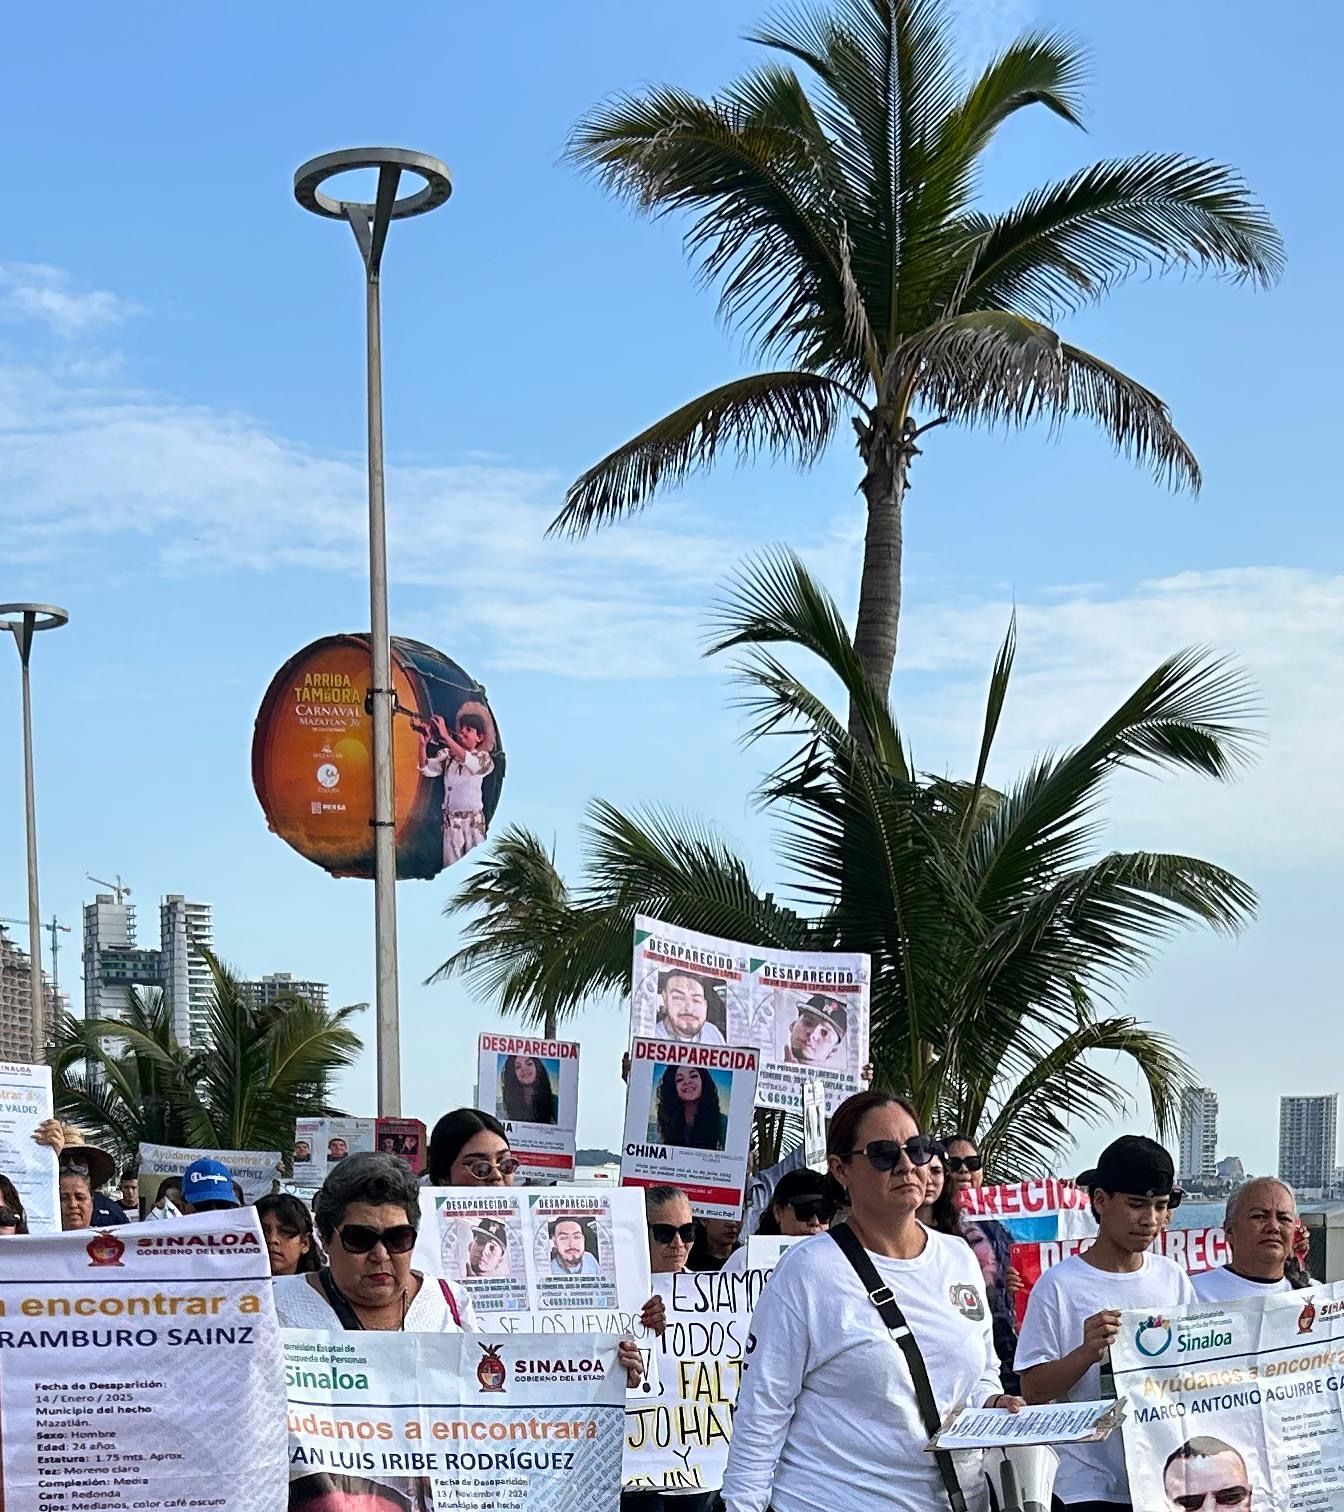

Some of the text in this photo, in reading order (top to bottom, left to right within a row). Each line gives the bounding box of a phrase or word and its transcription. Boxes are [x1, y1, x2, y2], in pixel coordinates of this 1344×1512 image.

[304, 673, 351, 688] ARRIBA
[294, 687, 361, 704] TAMBORA
[649, 938, 734, 970] DESAPARECIDO
[764, 965, 854, 985] DESAPARECIDO
[482, 1035, 577, 1060] DESAPARECIDA
[635, 1041, 757, 1071] DESAPARECIDA
[5, 1103, 39, 1114] VALDEZ
[626, 1143, 668, 1160] CHINA
[446, 1199, 508, 1210] DESAPARECIDO
[539, 1198, 599, 1209] DESAPARECIDO
[136, 1232, 259, 1247] SINALOA
[21, 1292, 226, 1317] encontrar
[238, 1294, 261, 1314] a
[166, 1326, 255, 1346] SAINZ
[1177, 1330, 1232, 1353] Sinaloa
[514, 1359, 605, 1373] SINALOA
[1134, 1402, 1186, 1425] MARCO
[1190, 1389, 1262, 1415] ANTONIO
[1265, 1379, 1323, 1403] AGUIRRE
[287, 1409, 393, 1442] údanos
[403, 1423, 422, 1441] a
[625, 1405, 738, 1448] JOHA
[291, 1446, 575, 1471] AN LUIS IRIBE RODRÍGUEZ
